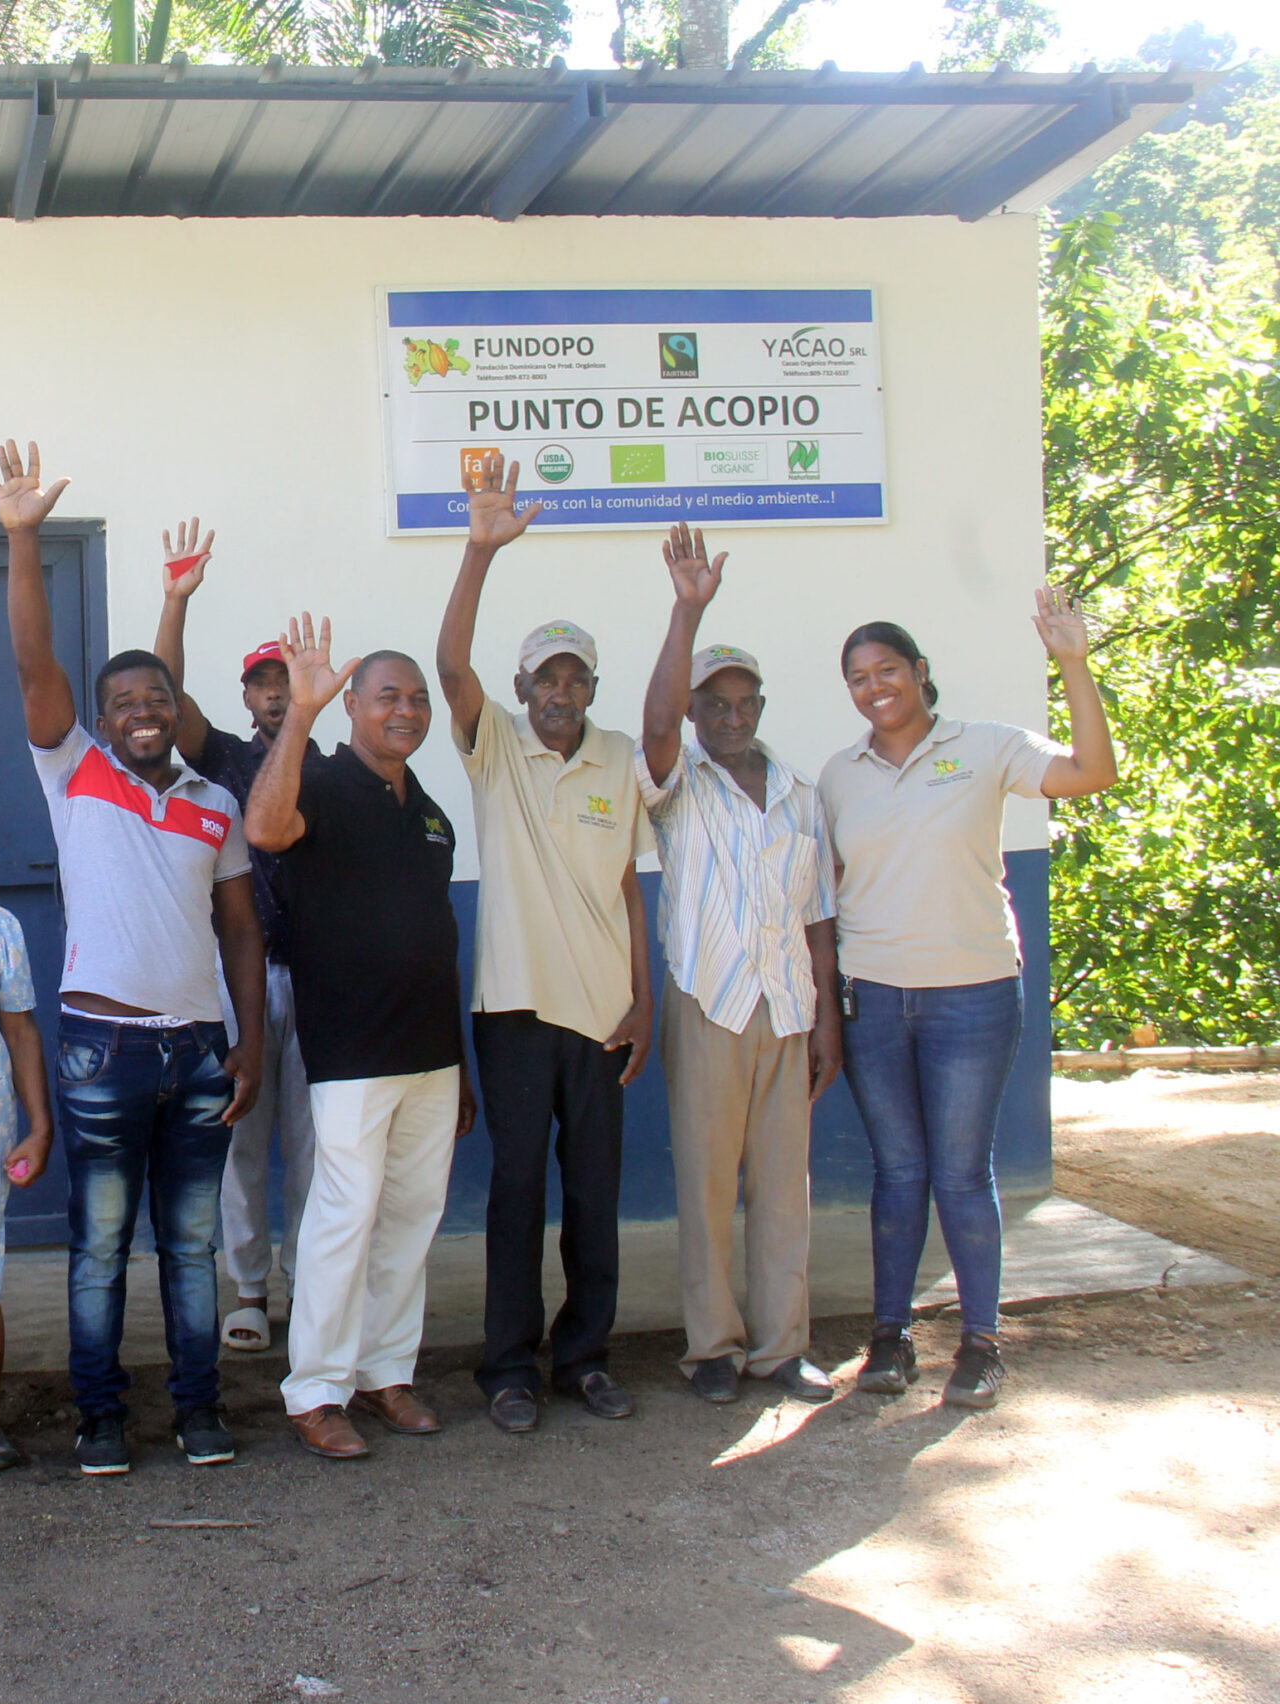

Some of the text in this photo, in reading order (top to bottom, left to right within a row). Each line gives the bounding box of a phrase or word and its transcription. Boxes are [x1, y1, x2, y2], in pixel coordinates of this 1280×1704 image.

[474, 337, 594, 357] FUNDOPO
[761, 338, 867, 357] YACAO SRL
[469, 395, 820, 431] PUNTO DE ACOPIO
[544, 454, 565, 463] USDA
[541, 465, 568, 473] ORGANIC
[711, 464, 754, 473] ORGANIC
[562, 499, 587, 510] con
[591, 495, 602, 508] la
[606, 494, 681, 508] comunidad
[685, 497, 692, 509] y
[696, 493, 708, 506] el
[712, 492, 754, 506] medio
